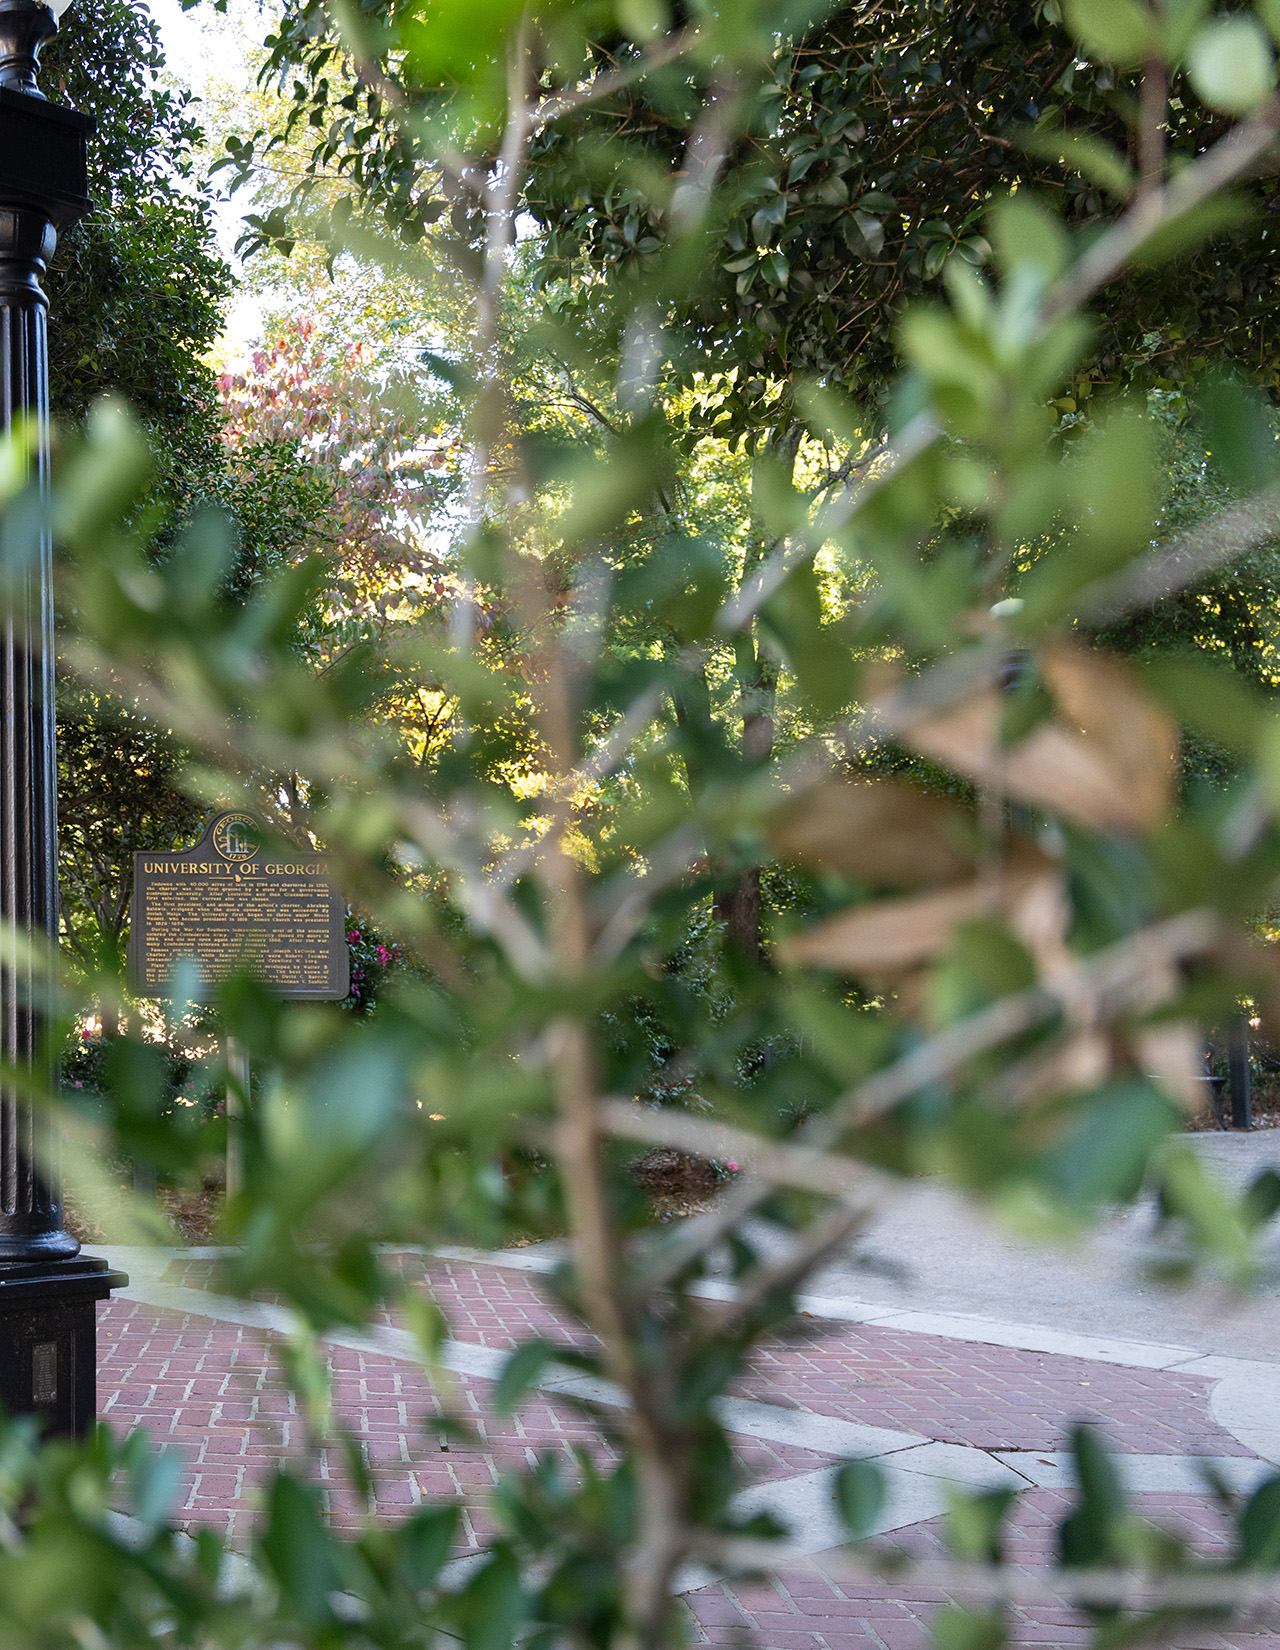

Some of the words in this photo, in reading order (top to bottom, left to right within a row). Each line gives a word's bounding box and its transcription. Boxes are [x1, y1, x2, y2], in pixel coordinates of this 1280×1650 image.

[144, 862, 234, 875] UNIVERSITY
[239, 863, 260, 875] OF
[265, 864, 330, 876] GEORGIA
